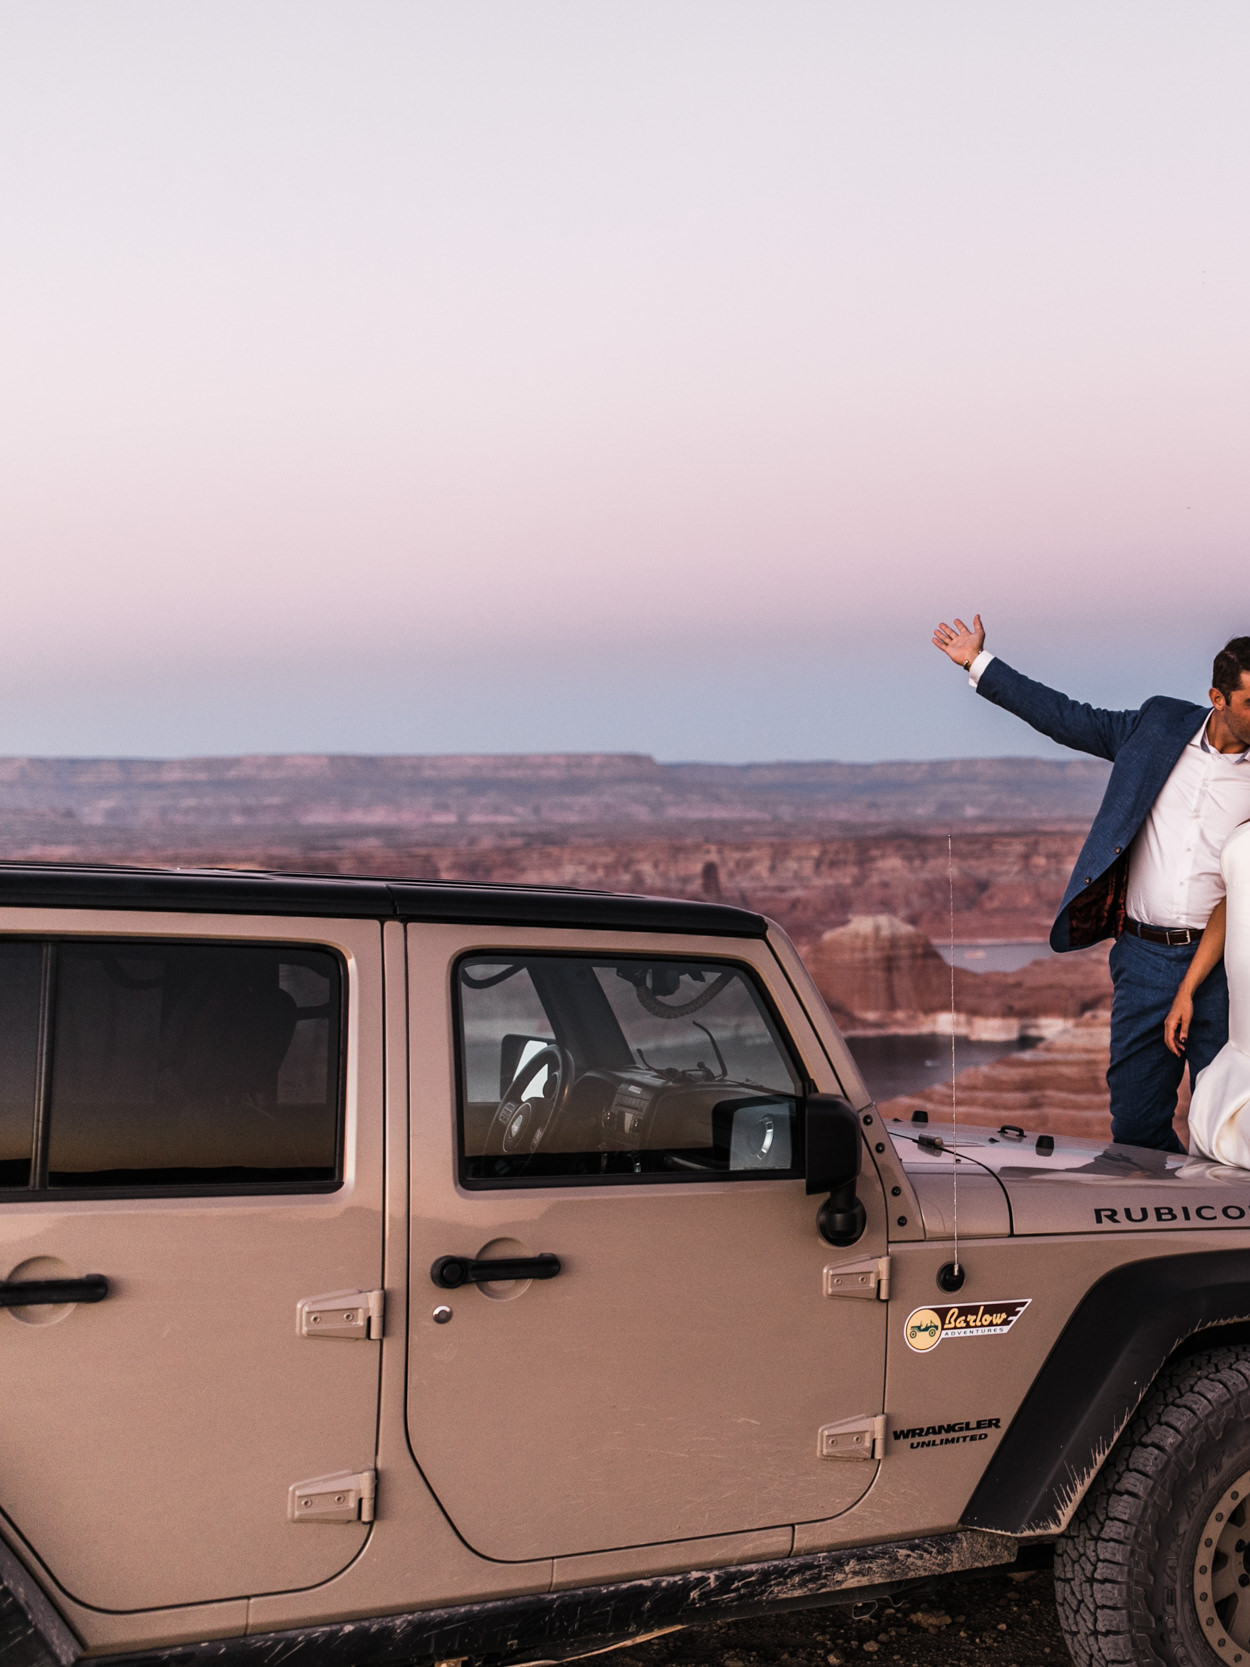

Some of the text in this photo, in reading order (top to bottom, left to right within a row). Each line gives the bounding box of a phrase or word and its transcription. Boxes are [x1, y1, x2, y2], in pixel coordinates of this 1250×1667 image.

[943, 1305, 1007, 1329] Barlow
[944, 1327, 1004, 1336] ADVENTURES
[892, 1417, 1001, 1440] WRANGLER
[909, 1433, 988, 1449] UNLIMITED
